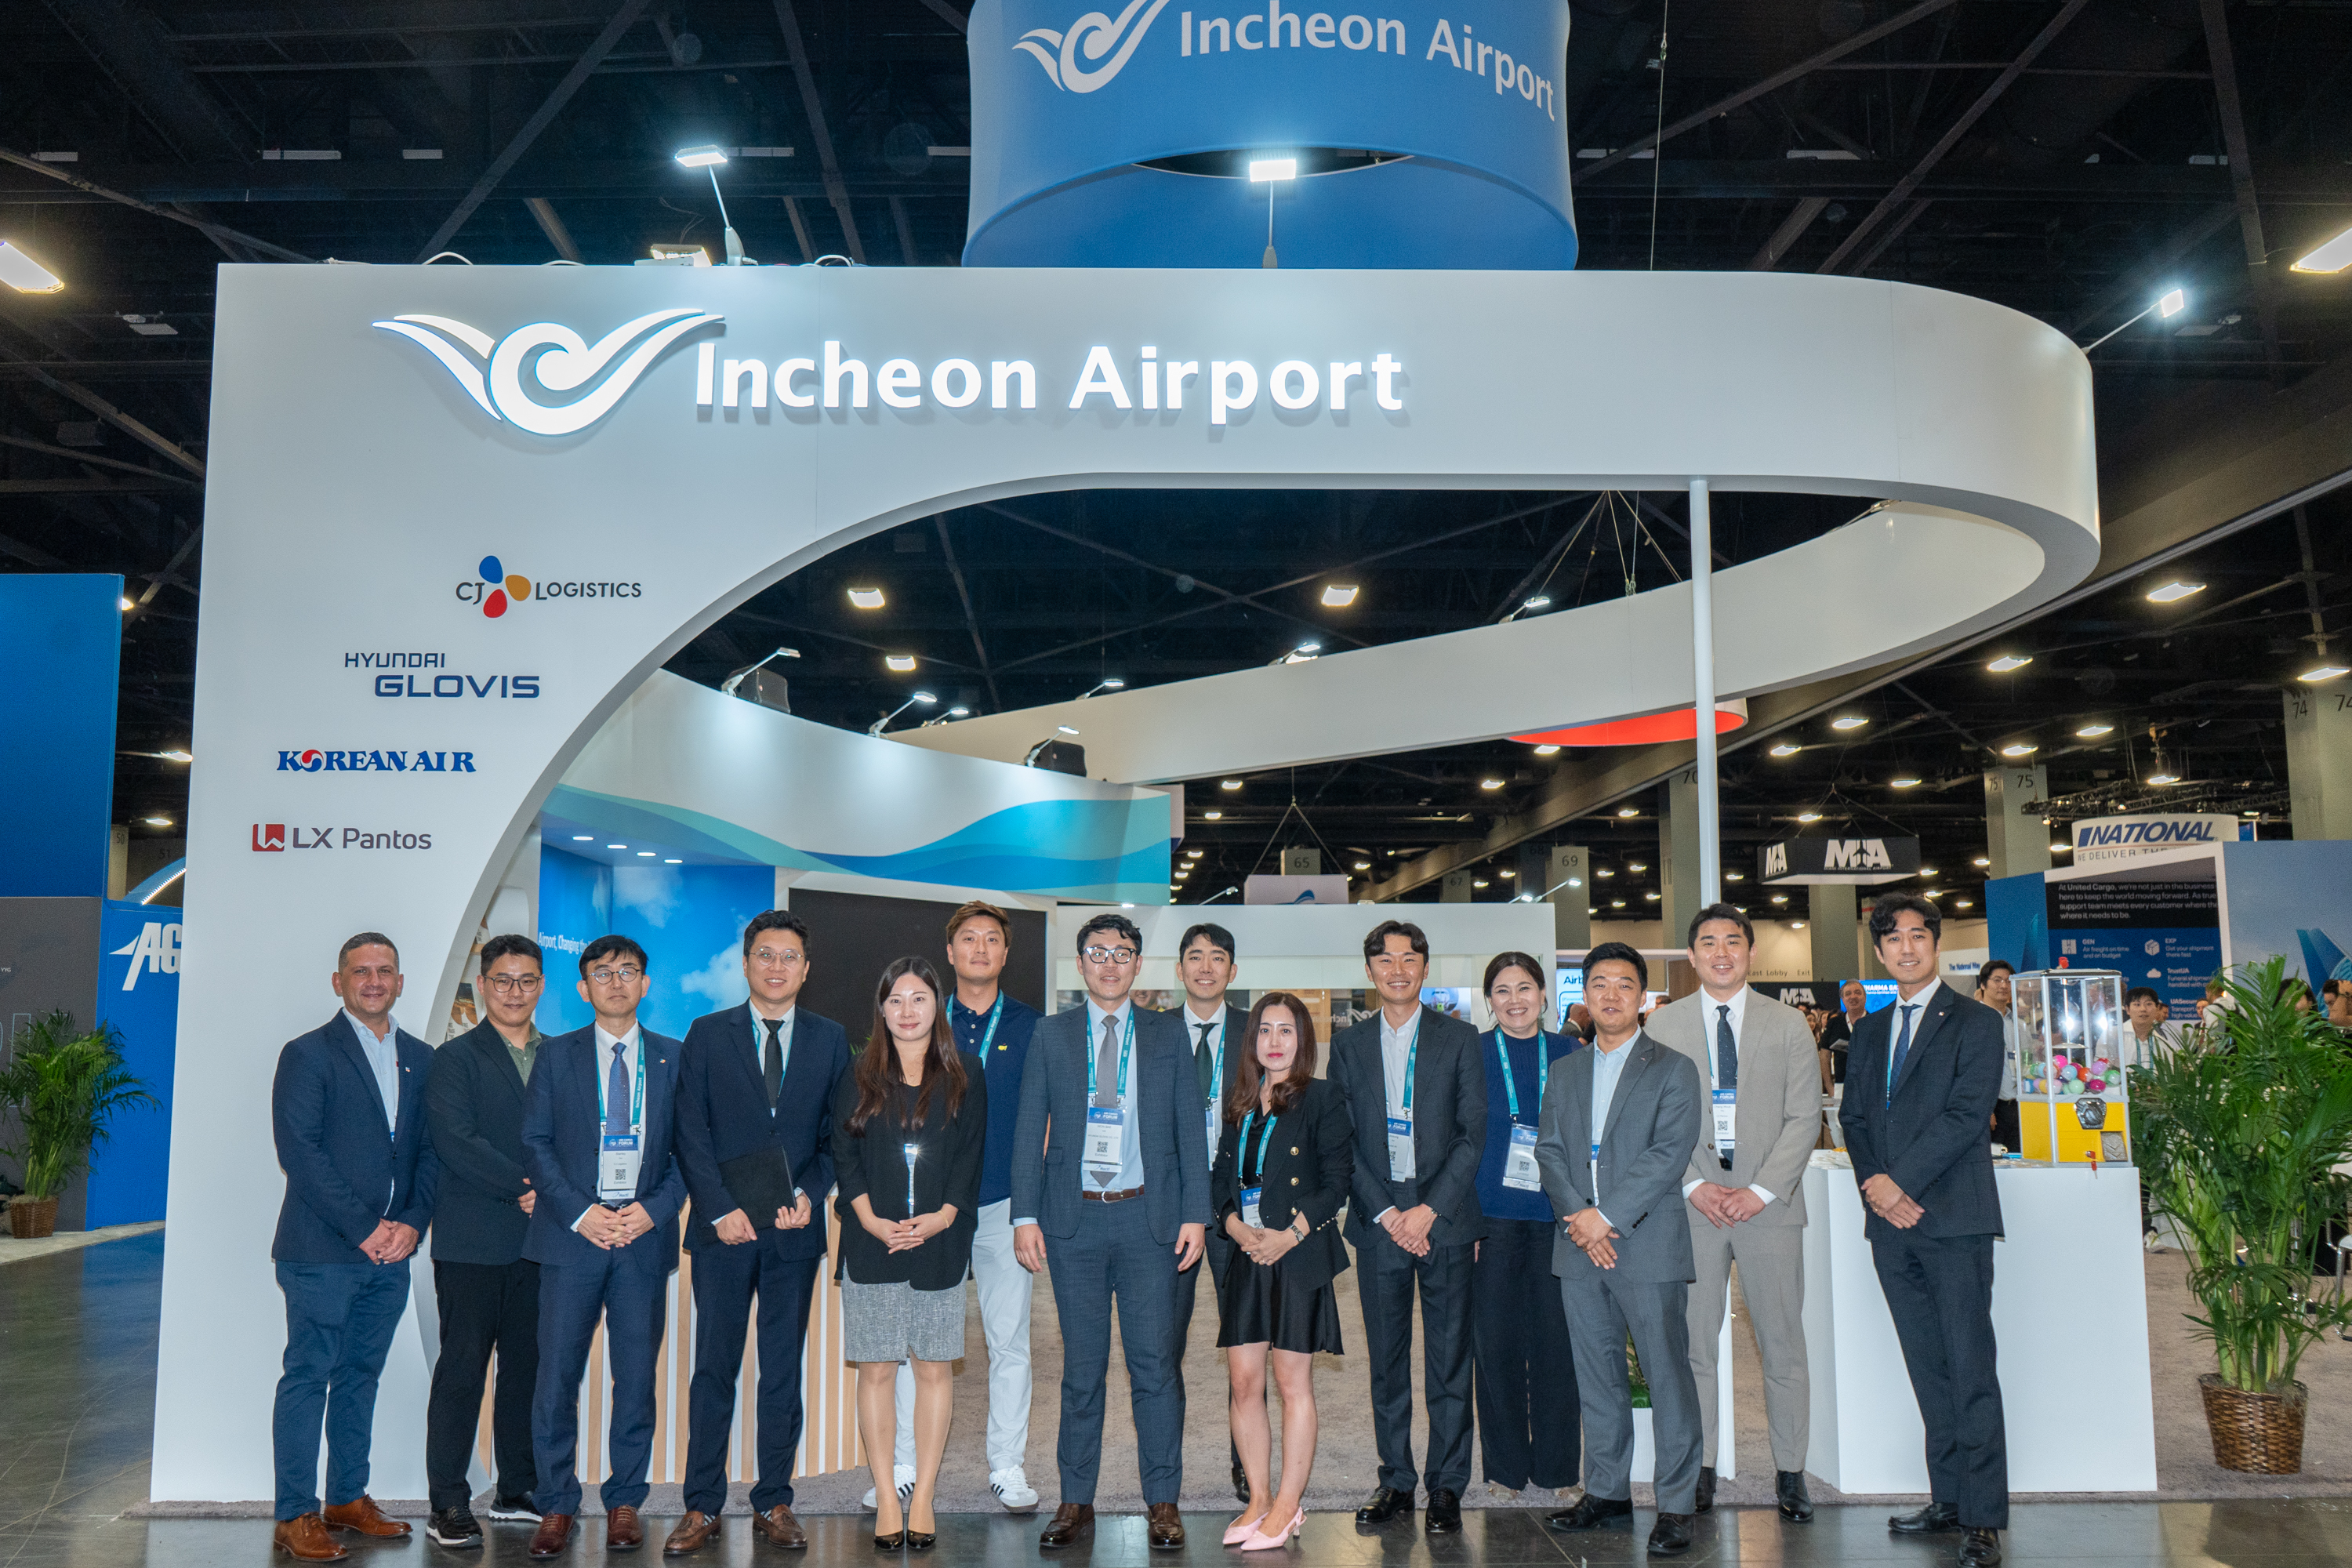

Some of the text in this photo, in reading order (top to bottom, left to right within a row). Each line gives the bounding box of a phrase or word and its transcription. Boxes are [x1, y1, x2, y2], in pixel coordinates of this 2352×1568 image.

[1181, 0, 1555, 122] Incheon Airport
[696, 339, 1404, 426] Incheon Airport
[456, 582, 642, 605] CJ LOGISTICS
[344, 652, 445, 668] HYUNDAI
[374, 674, 540, 699] GLOVIS
[277, 749, 477, 773] KOREAN AIR
[2017, 775, 2034, 788] 75
[293, 827, 432, 850] LX Pantos
[2090, 821, 2216, 847] NATIONAL
[1294, 857, 1309, 868] 65
[1562, 855, 1578, 866] 69
[2089, 848, 2136, 860] DELIVER
[2084, 893, 2101, 902] keep
[2136, 892, 2161, 901] moving
[538, 931, 557, 951] Airport,
[558, 935, 579, 955] Changing
